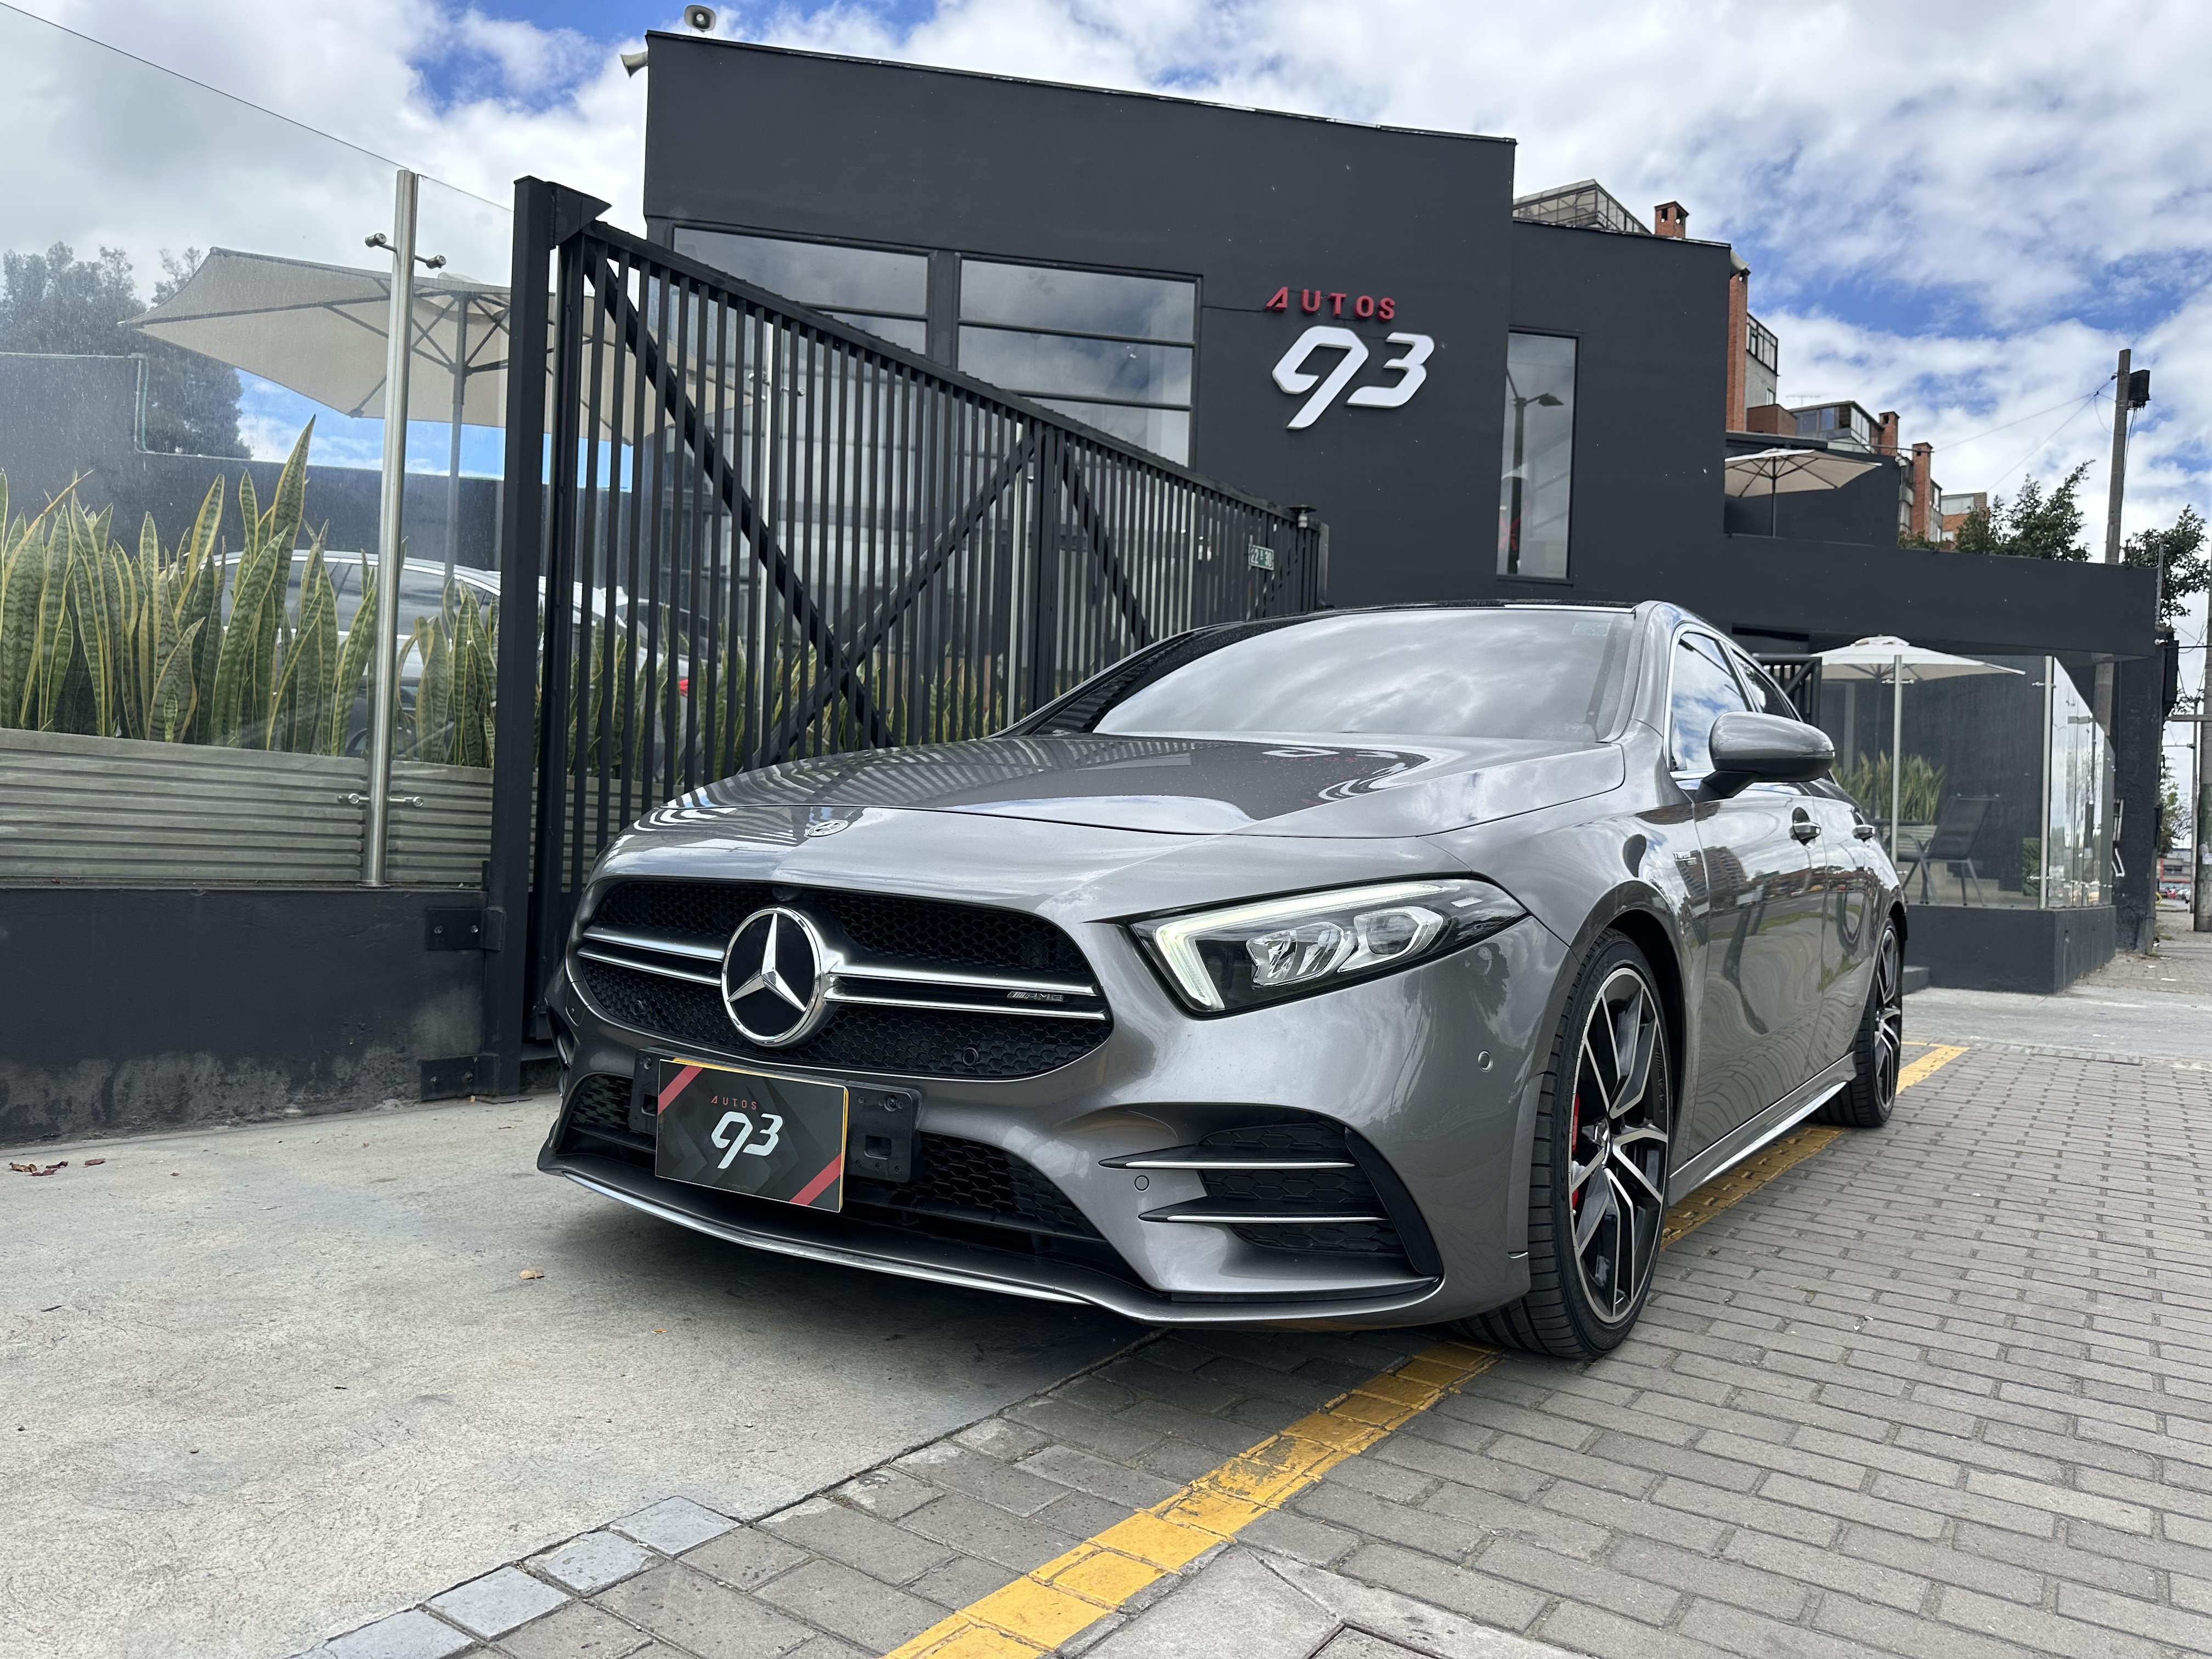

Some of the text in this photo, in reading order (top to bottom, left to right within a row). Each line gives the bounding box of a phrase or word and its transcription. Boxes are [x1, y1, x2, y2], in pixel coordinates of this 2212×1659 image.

[1265, 286, 1396, 321] AUTOS
[1272, 325, 1435, 430] 93
[711, 1095, 757, 1110] AUTOS
[711, 1111, 783, 1169] 93
